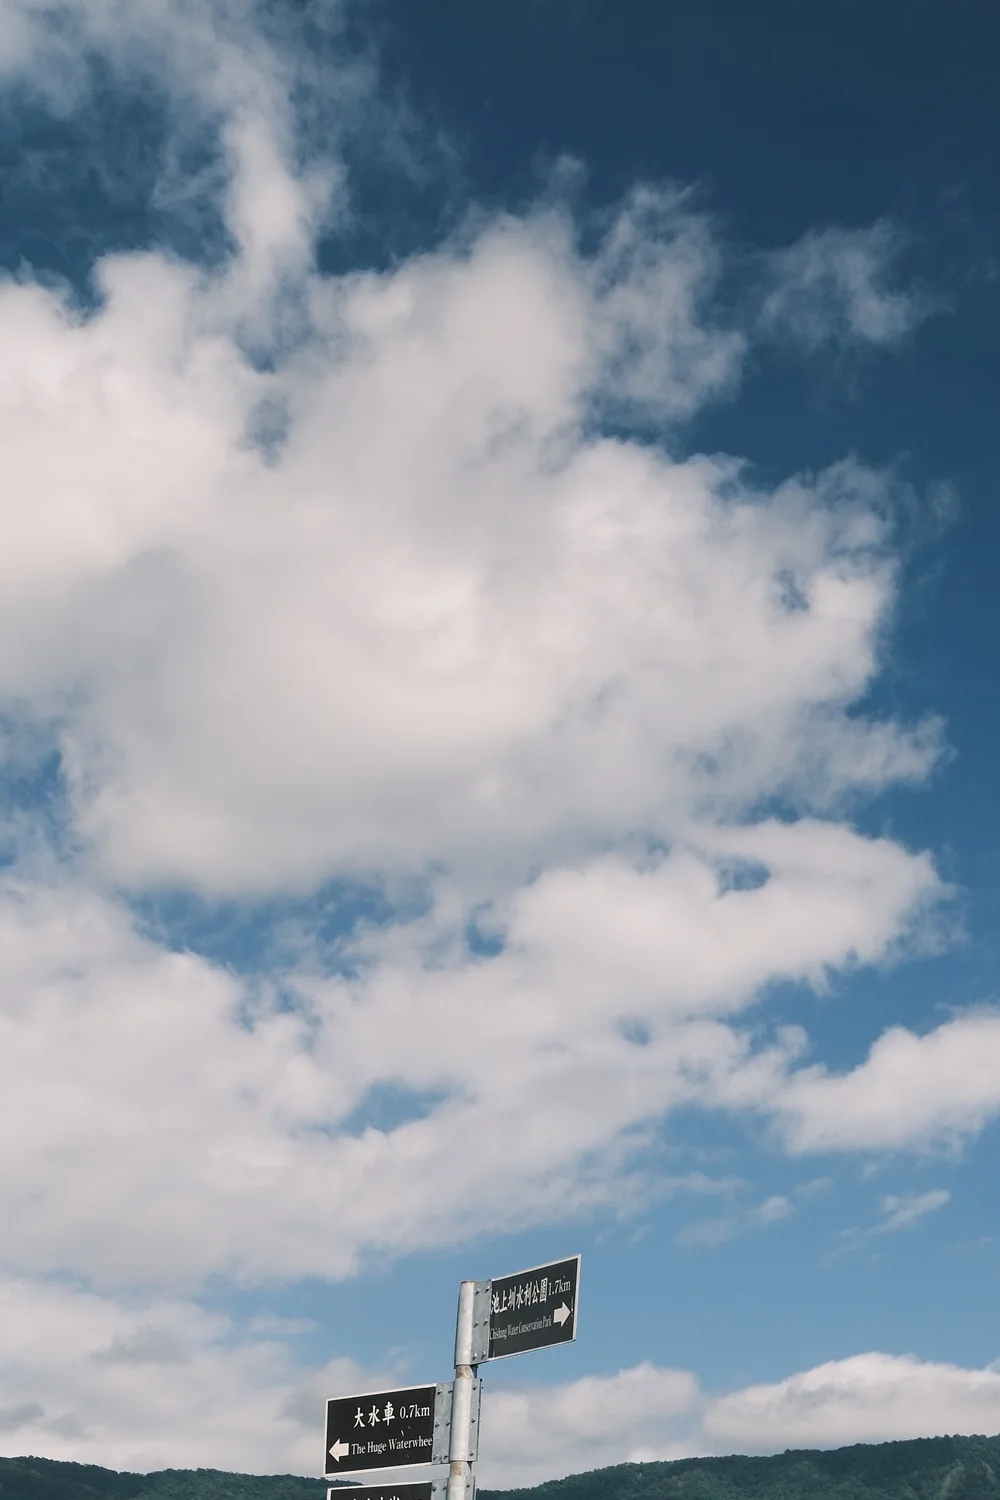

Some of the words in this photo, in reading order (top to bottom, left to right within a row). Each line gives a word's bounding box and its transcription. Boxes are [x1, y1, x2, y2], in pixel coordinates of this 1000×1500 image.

[548, 1279, 571, 1296] 1.7km
[542, 1315, 552, 1328] Park
[353, 1401, 396, 1429] 大水車
[399, 1404, 430, 1420] 0.7km
[351, 1443, 366, 1455] The
[367, 1441, 387, 1455] Huge
